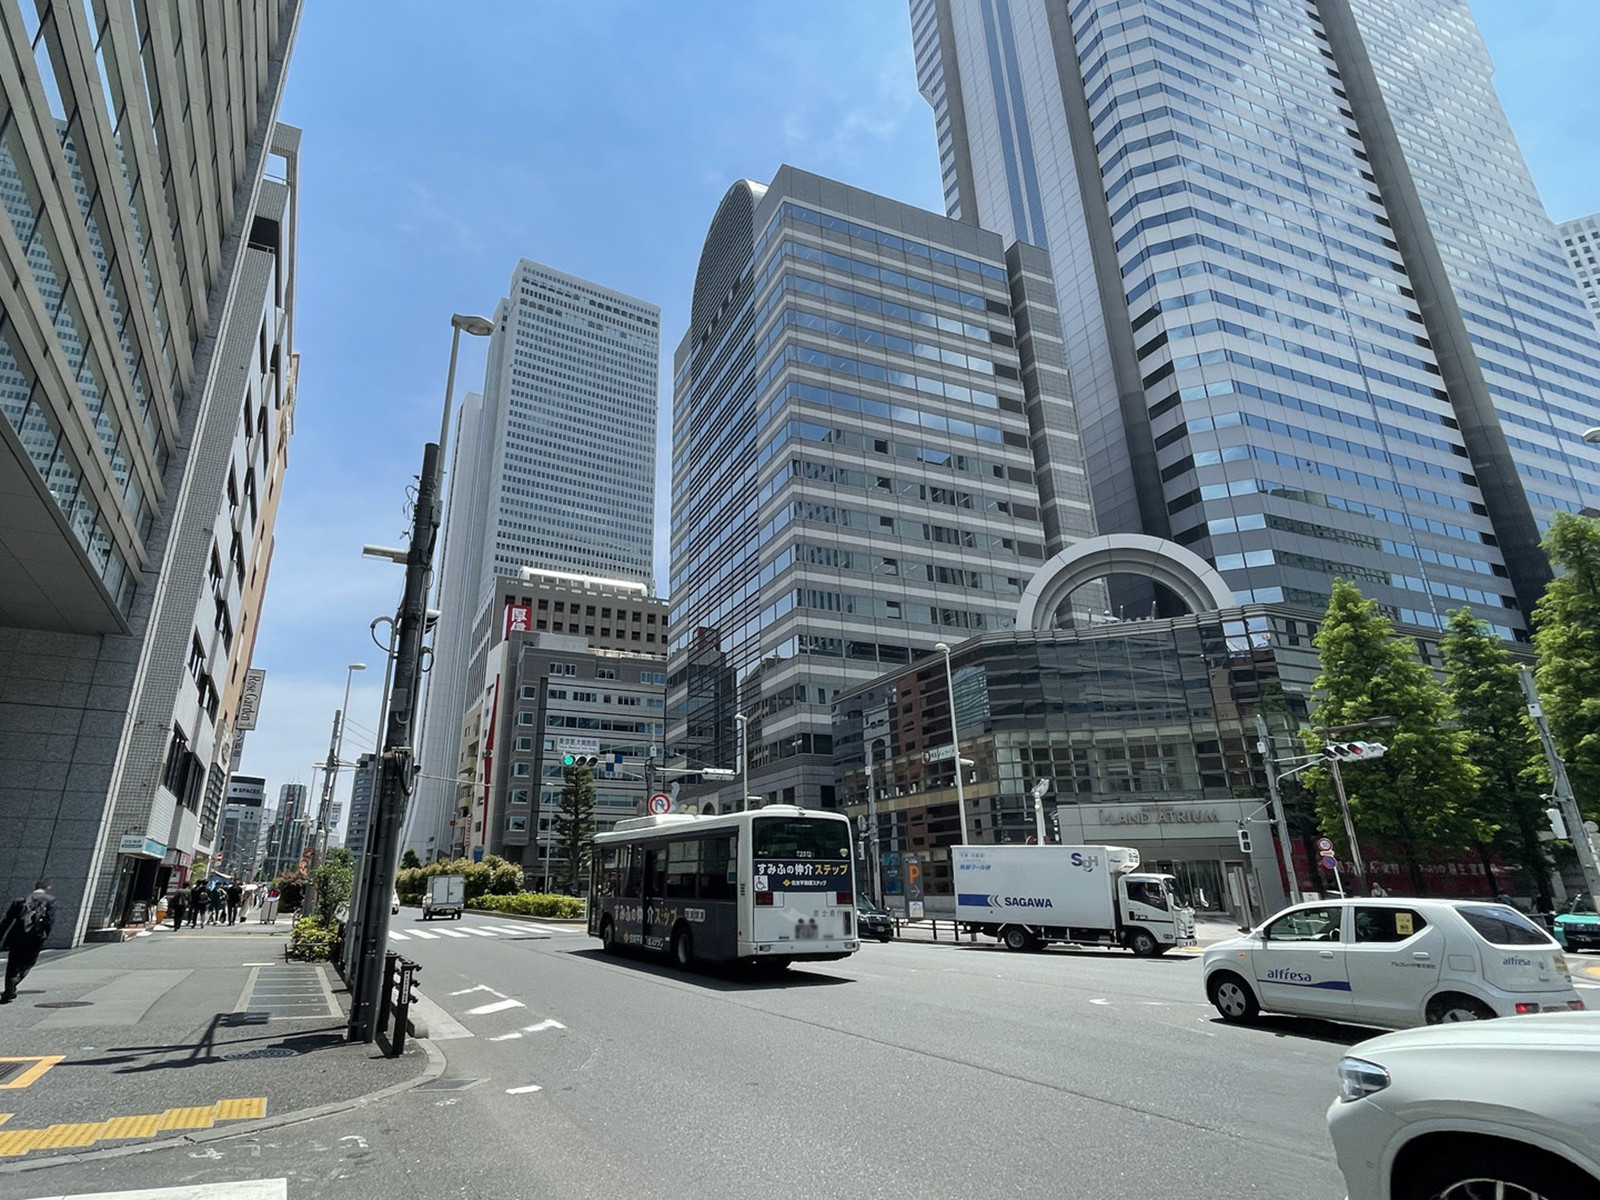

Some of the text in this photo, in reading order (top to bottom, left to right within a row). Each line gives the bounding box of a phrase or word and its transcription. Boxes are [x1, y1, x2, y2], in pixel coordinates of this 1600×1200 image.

[246, 675, 262, 692] Rose
[1157, 808, 1219, 824] ATRIUM
[757, 863, 848, 876] すみふの仲介ステップ
[908, 864, 921, 885] P
[1004, 896, 1053, 909] SAGAWA
[1502, 955, 1531, 966] alfresa
[1267, 966, 1312, 982] alfresa
